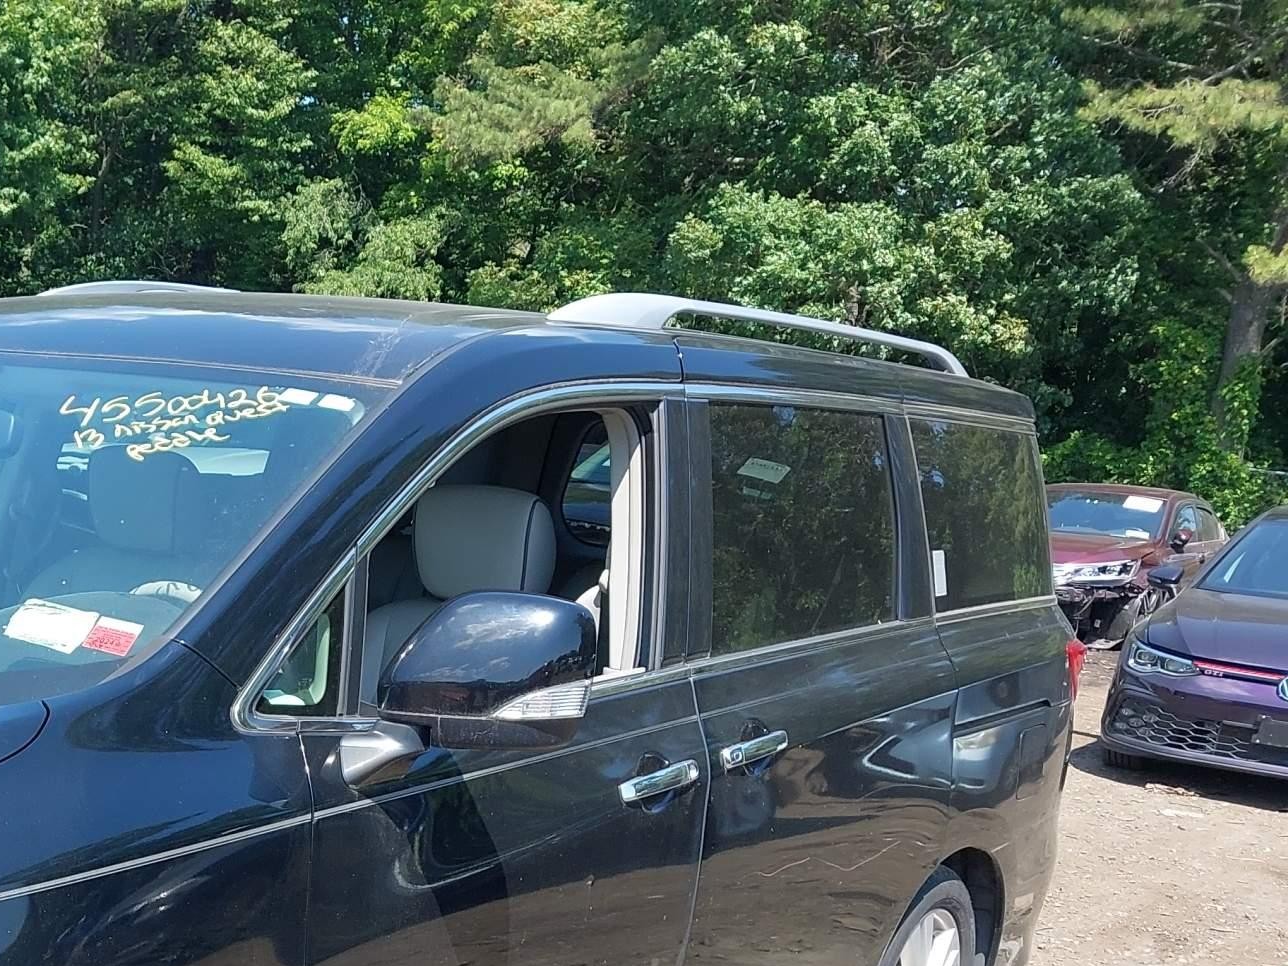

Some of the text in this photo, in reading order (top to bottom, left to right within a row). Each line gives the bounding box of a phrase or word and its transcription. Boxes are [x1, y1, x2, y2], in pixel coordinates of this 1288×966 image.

[59, 386, 280, 428] 45500426
[73, 428, 106, 449] 13
[1204, 669, 1224, 677] GTI
